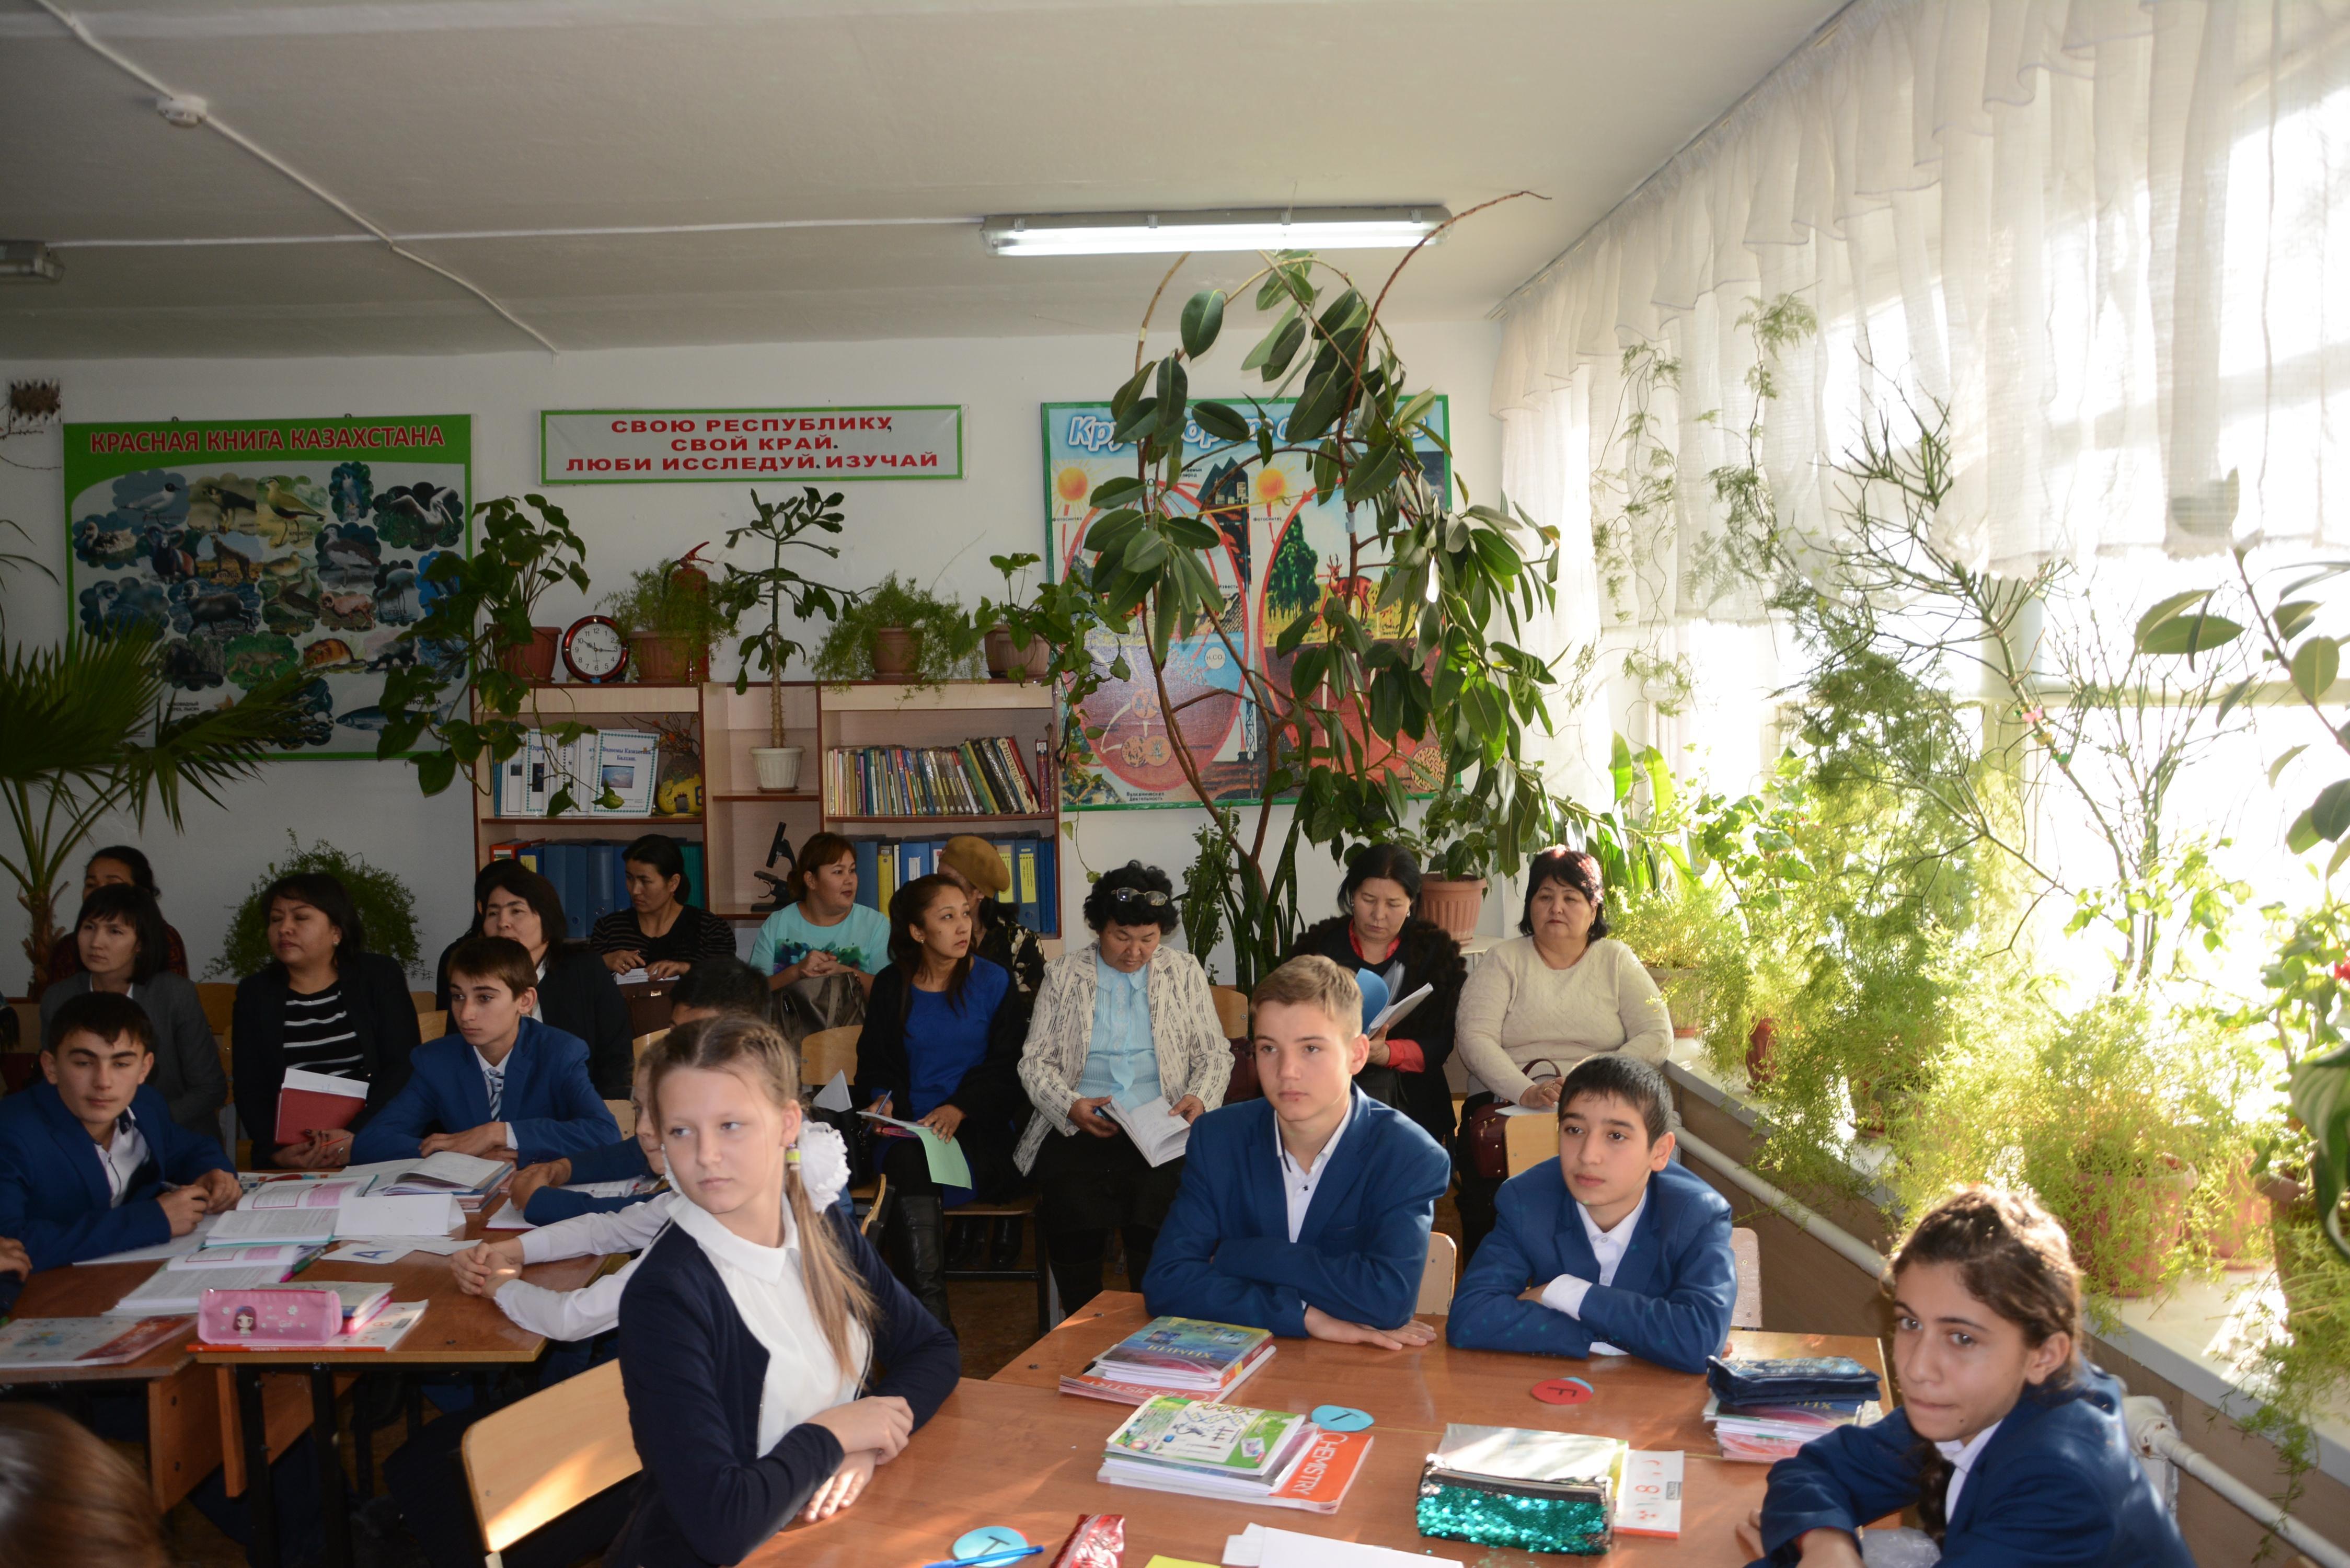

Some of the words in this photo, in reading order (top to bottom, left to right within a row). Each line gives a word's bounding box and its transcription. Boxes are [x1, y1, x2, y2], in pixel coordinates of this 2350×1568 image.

[610, 419, 697, 434] СВОЮ
[706, 416, 893, 433] РЕСПУБЛИКУ,
[91, 431, 200, 453] КРАСНАЯ
[206, 429, 285, 451] КНИГА
[291, 425, 445, 449] КАЗАХСТАНА
[671, 436, 748, 452] СВОЙ
[758, 434, 838, 451] КРАЙ.
[566, 457, 652, 472] ЛЮБИ
[825, 451, 938, 469] ИЗУЧАЙ
[1146, 1344, 1213, 1359] ХИМИЯ
[1293, 1432, 1349, 1496] CHEMISTRY
